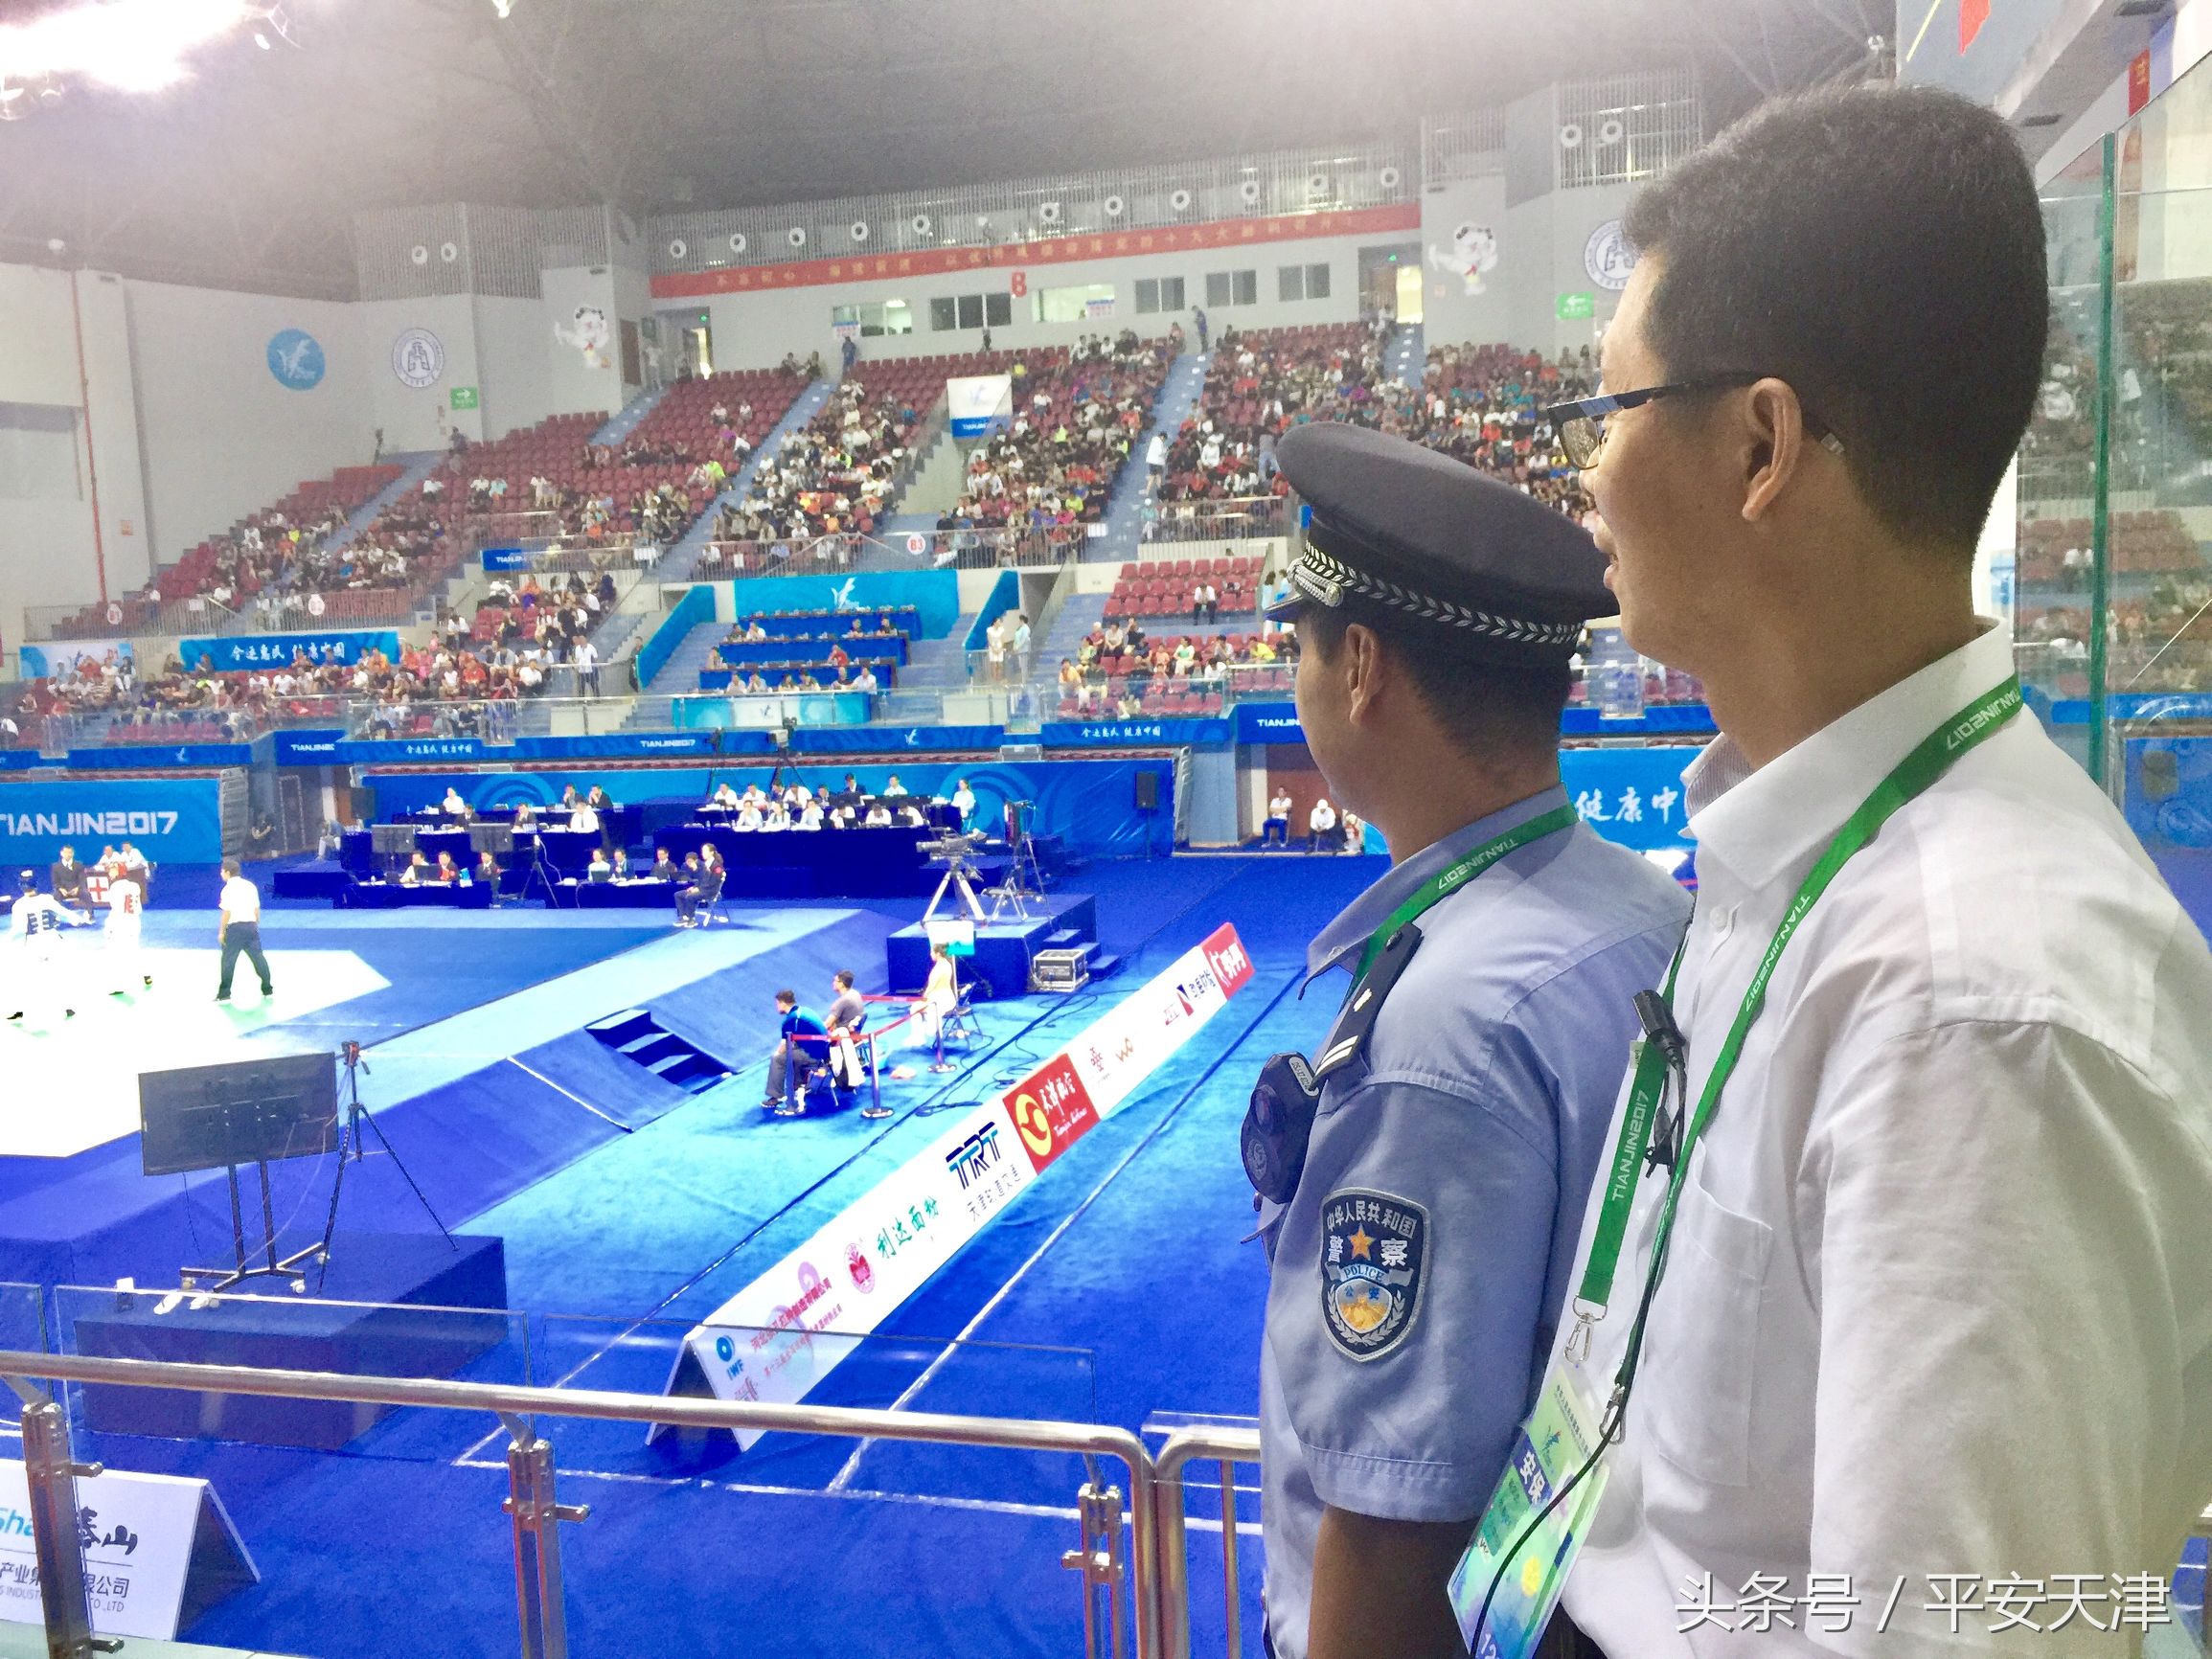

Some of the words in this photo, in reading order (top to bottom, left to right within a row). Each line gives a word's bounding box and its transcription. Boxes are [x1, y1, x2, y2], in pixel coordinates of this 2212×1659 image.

[1011, 271, 1027, 298] B
[1438, 838, 1518, 890] TIANJIN2017
[1745, 895, 1812, 1012] TIANJIN2017
[946, 1121, 1001, 1190] TRT
[1611, 1089, 1650, 1202] TIANJIN2017
[1327, 1199, 1418, 1239] 中华人民共和国
[1343, 1263, 1384, 1282] POLICE
[726, 1358, 744, 1381] IWF
